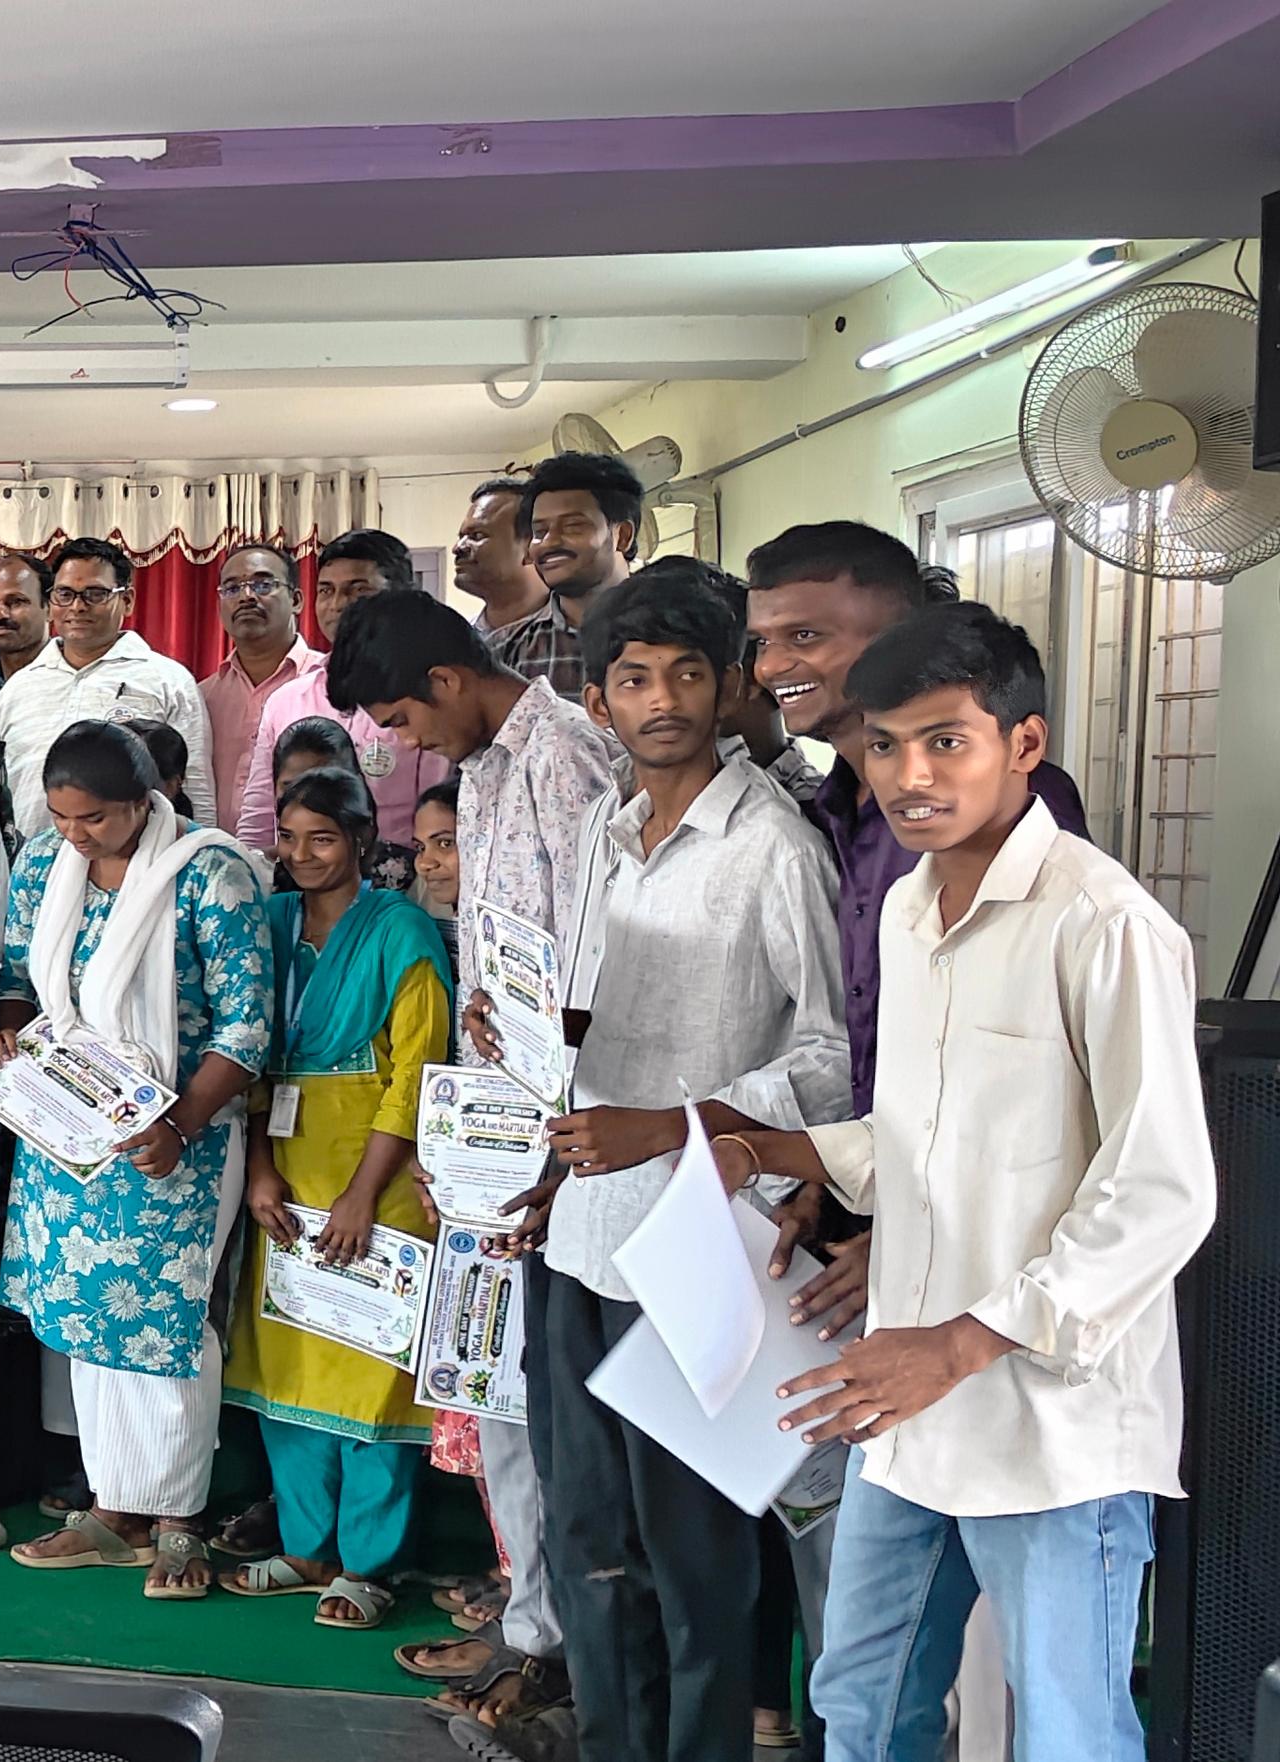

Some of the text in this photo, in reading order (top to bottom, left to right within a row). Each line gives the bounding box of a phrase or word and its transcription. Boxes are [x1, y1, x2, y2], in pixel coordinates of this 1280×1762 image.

[1116, 433, 1176, 460] Crompton
[49, 1052, 69, 1072] YOGA
[473, 1104, 488, 1112] ONE
[461, 1116, 487, 1129] YOGA
[498, 1119, 526, 1132] MARTIAL
[528, 1123, 540, 1133] ARTS
[374, 1265, 390, 1278] ARTS
[483, 1265, 495, 1285] ARTS
[475, 1287, 490, 1321] MARTIAL
[460, 1314, 469, 1330] DAY
[458, 1331, 468, 1348] ONE
[469, 1333, 483, 1362] YOGA
